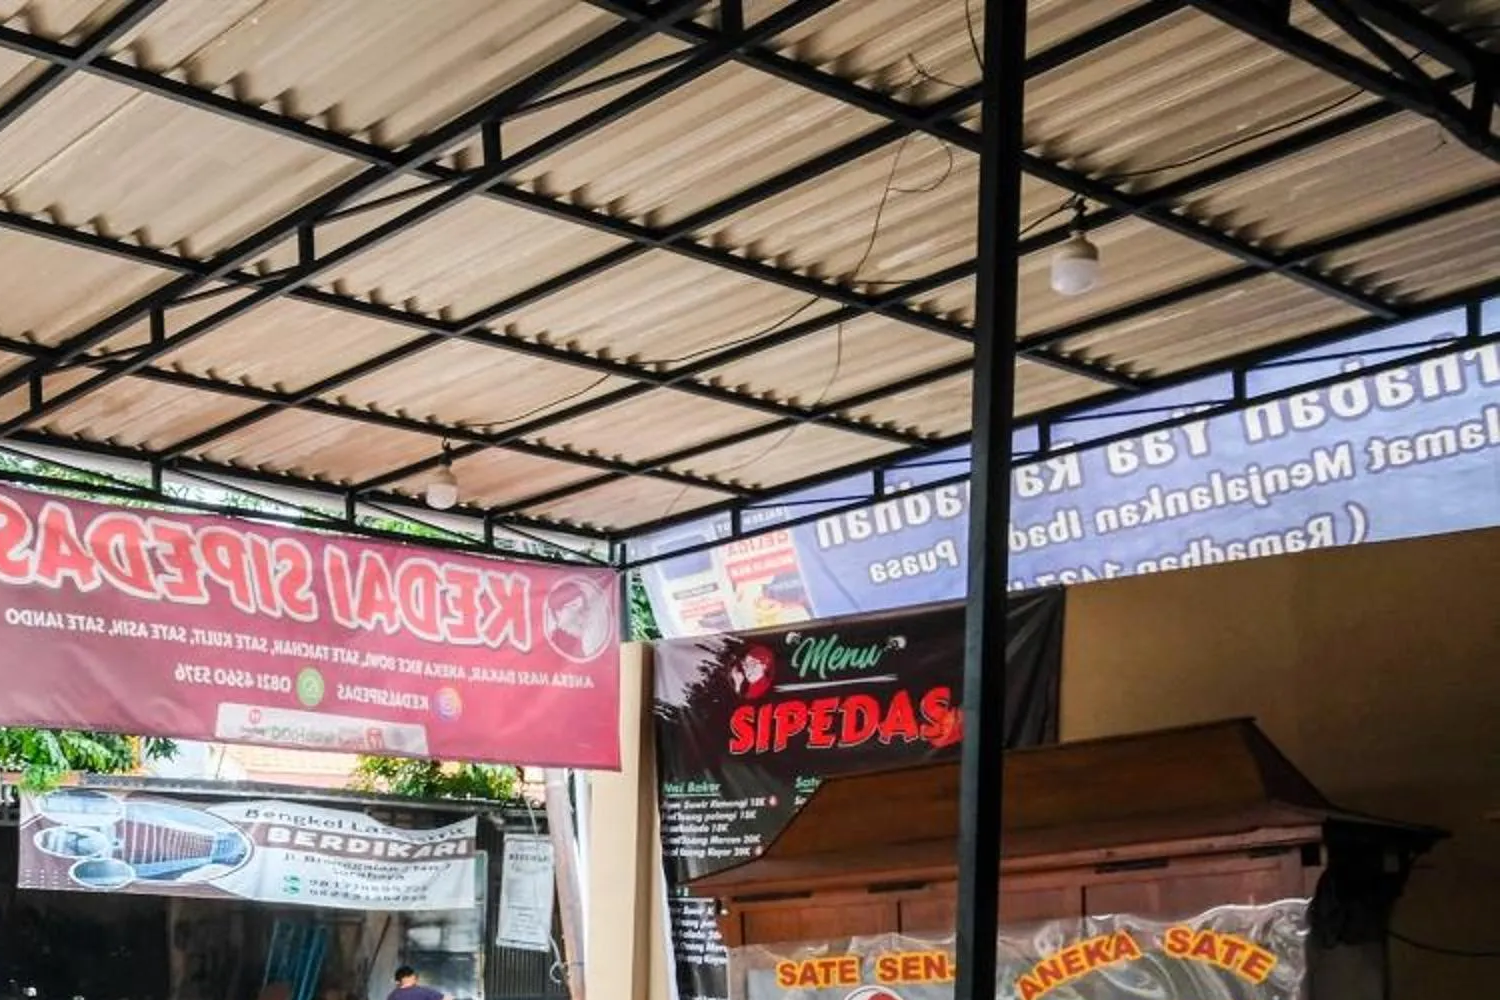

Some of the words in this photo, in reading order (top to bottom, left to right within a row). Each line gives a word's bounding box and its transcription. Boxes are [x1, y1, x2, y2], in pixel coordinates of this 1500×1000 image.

[790, 633, 883, 680] Menu
[728, 686, 952, 756] SIPEDAS
[244, 808, 343, 830] Bengkel
[264, 825, 472, 859] BERDIKARI
[777, 958, 861, 989] SATE
[877, 954, 956, 986] SEN
[1164, 923, 1276, 984] SATE
